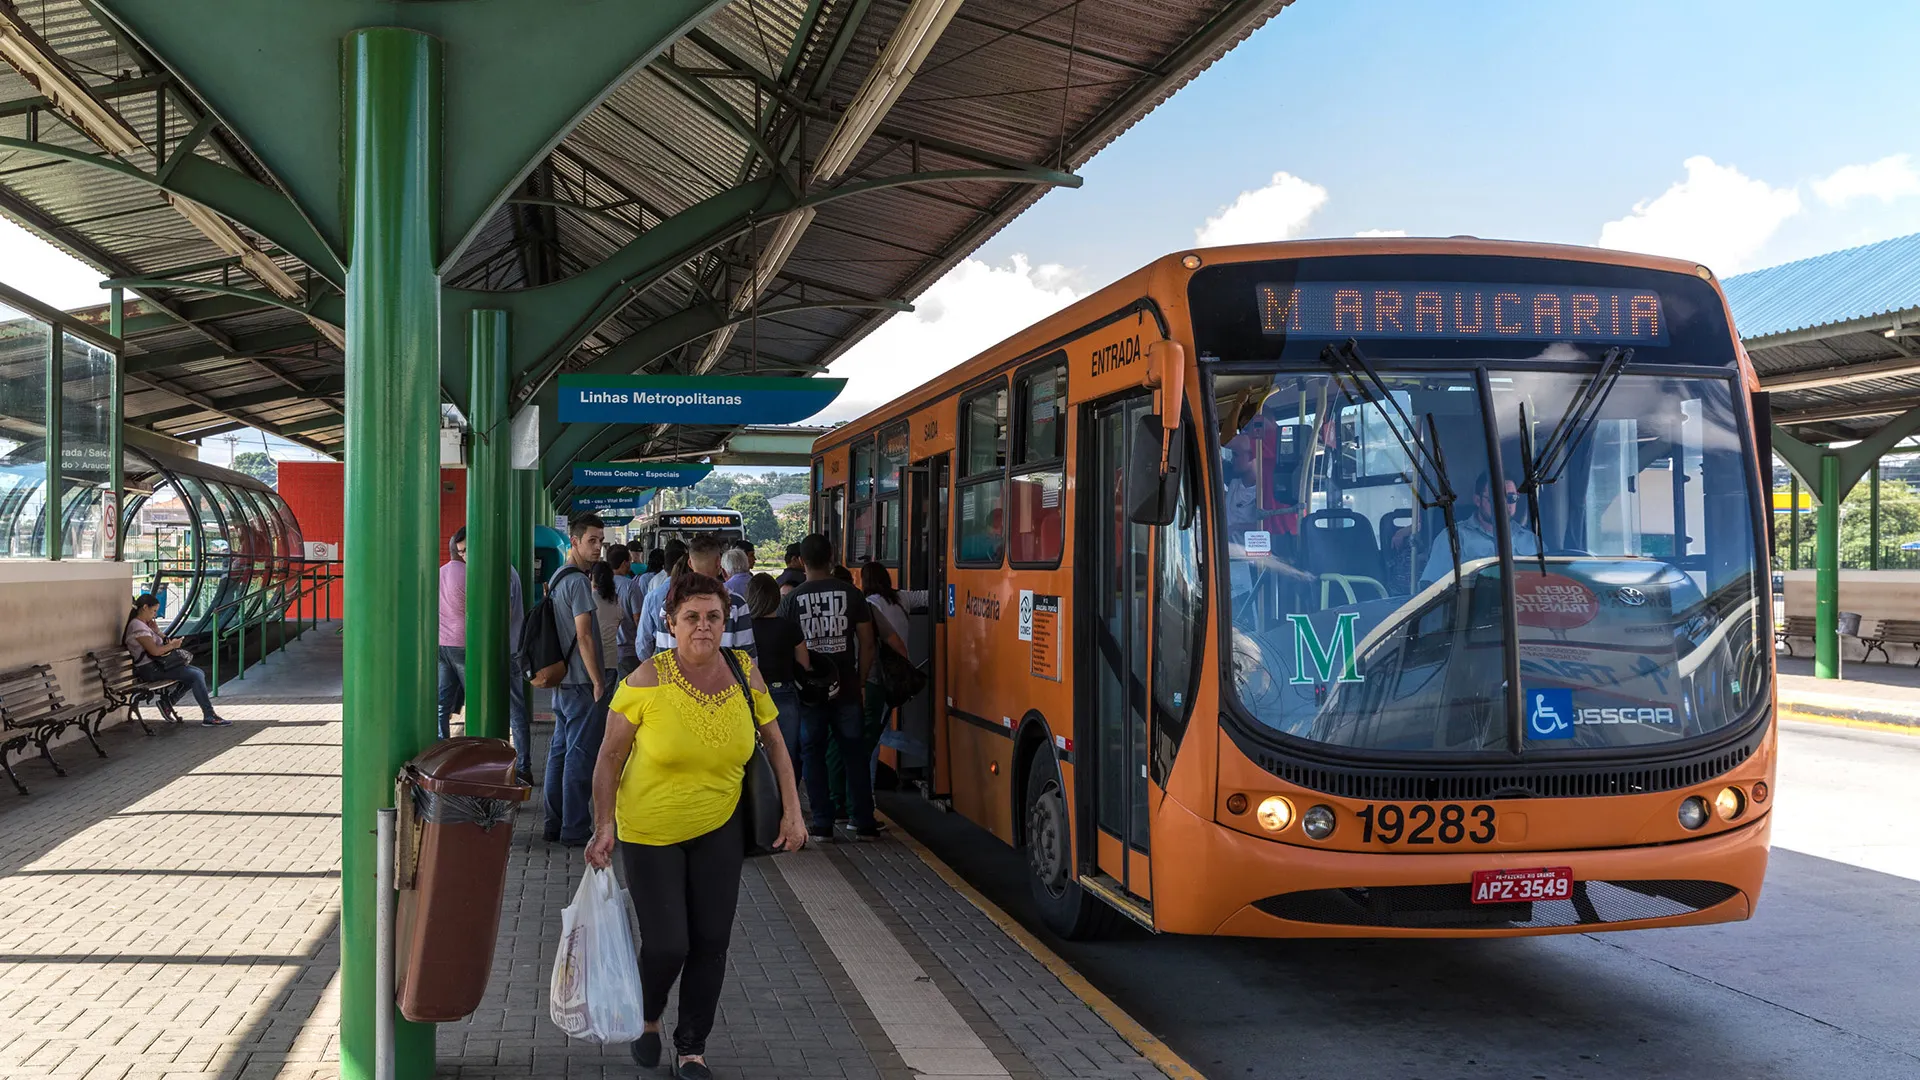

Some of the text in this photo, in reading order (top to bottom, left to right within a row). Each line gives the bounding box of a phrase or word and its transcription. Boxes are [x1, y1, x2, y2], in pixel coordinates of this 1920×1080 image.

[1263, 287, 1660, 336] M ARAUCARIA
[1091, 334, 1141, 378] ENTRADA
[580, 391, 742, 407] Linhas Metropolitanas
[61, 448, 82, 458] rada
[61, 461, 73, 469] do
[584, 469, 612, 477] Thomas
[645, 470, 680, 479] Especiais
[680, 516, 731, 525] RODOVIARIA
[966, 589, 1000, 621] Araucária
[800, 615, 849, 640] KAPAP
[1286, 612, 1365, 685] M
[1573, 707, 1673, 725] USSCAR
[1355, 803, 1498, 845] 19283
